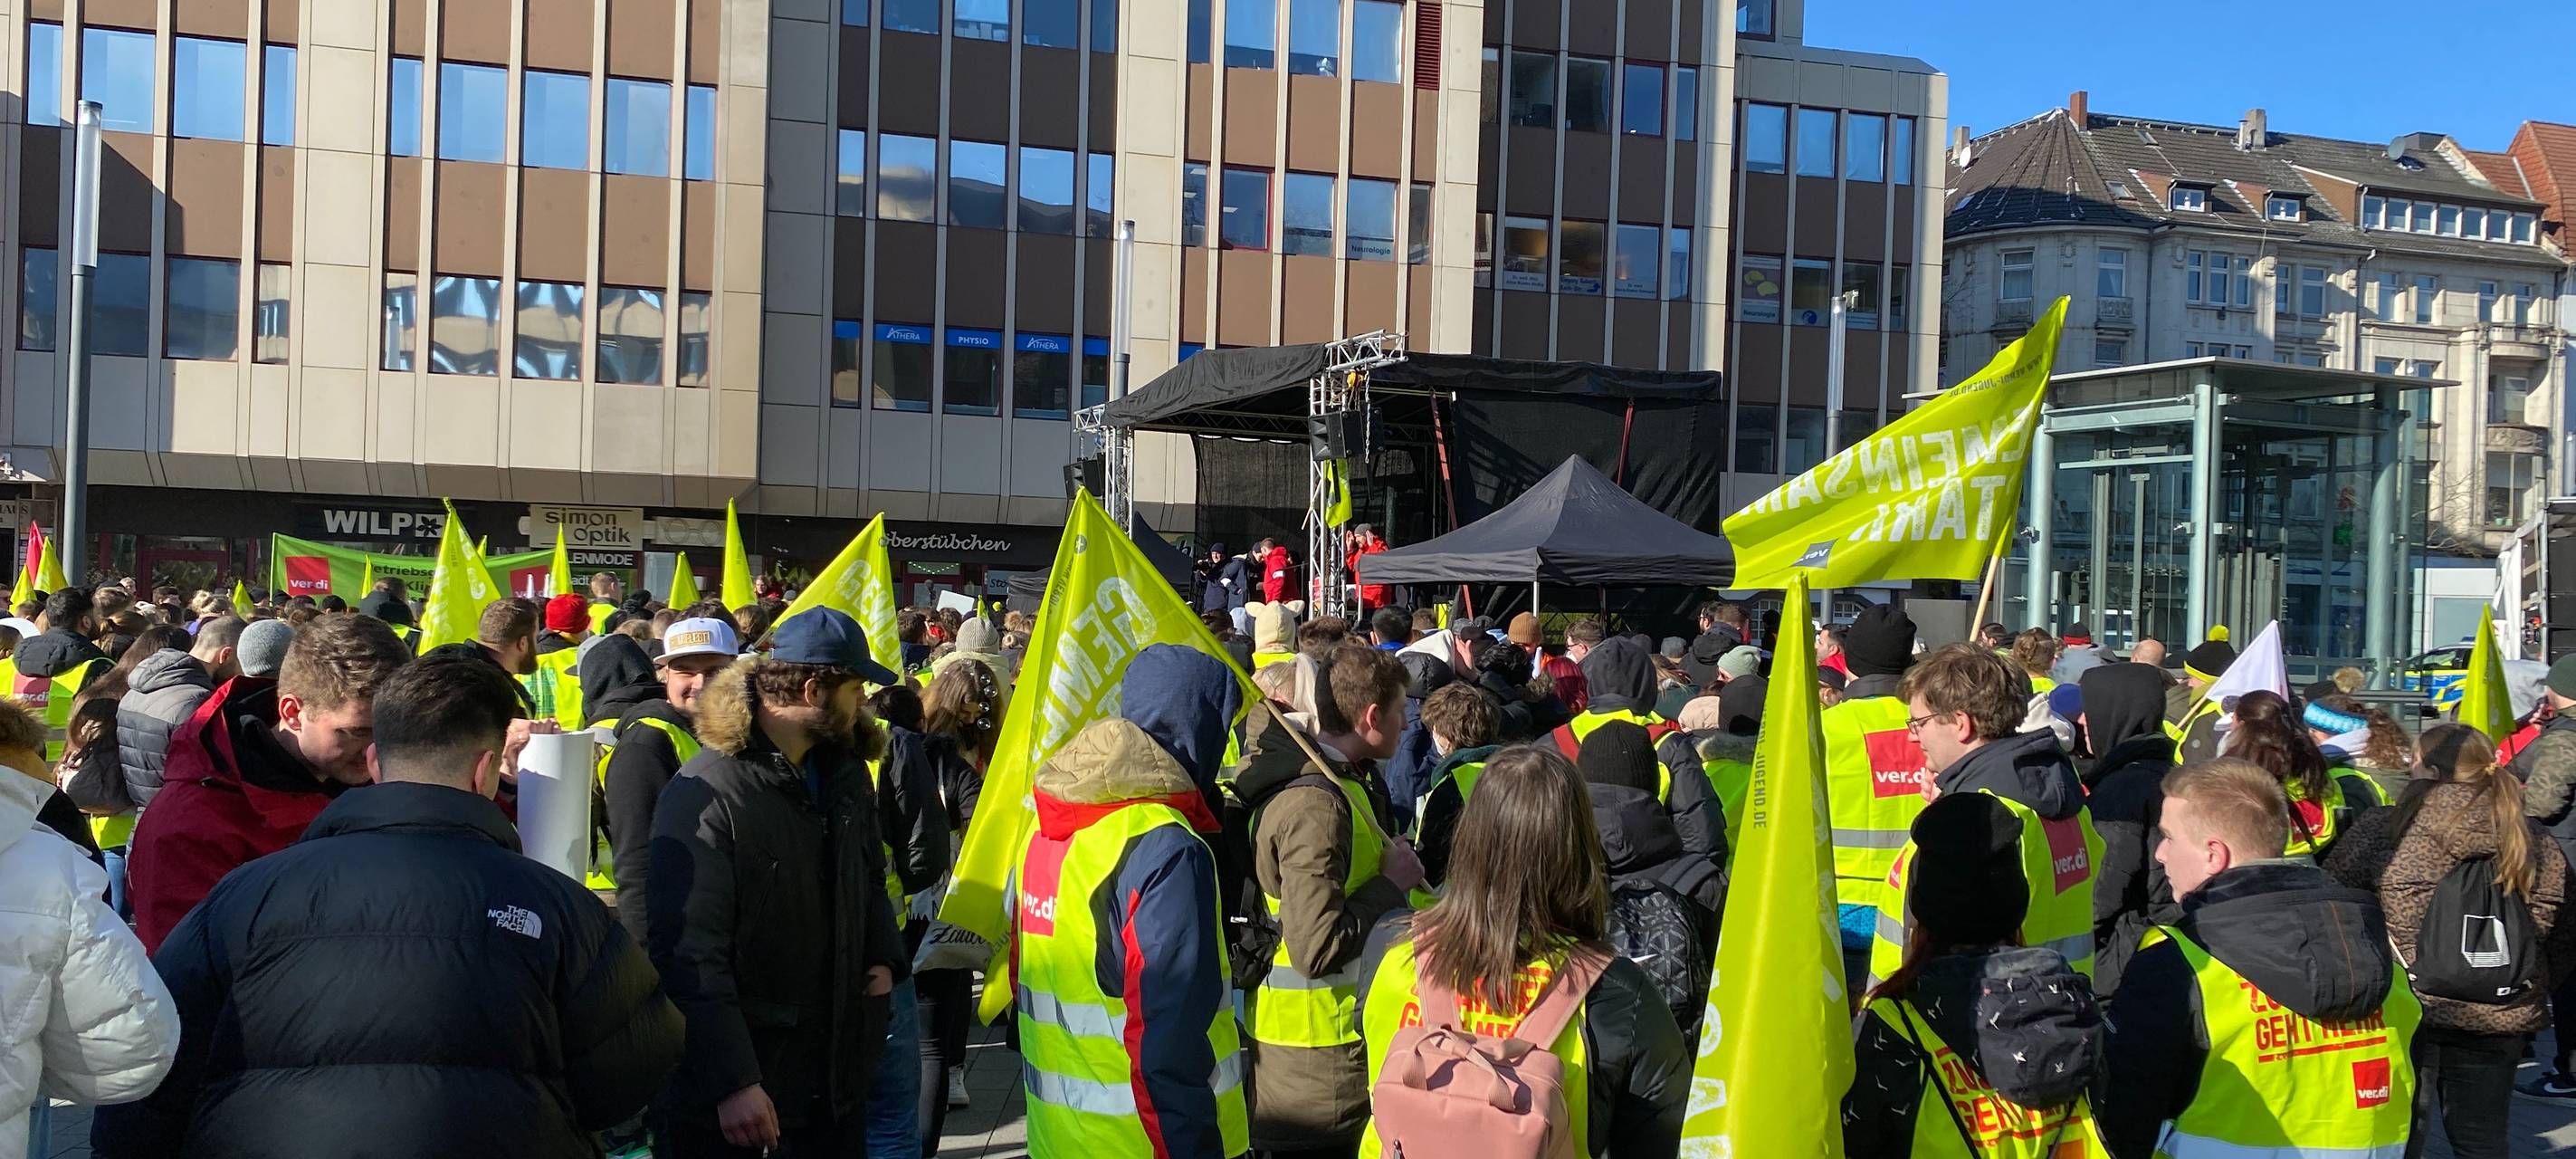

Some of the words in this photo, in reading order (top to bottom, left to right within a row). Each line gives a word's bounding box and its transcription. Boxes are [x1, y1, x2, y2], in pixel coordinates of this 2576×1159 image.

[1351, 245, 1391, 254] Neurologie
[887, 327, 921, 340] ATHERA
[959, 336, 989, 345] PHYSIO
[1027, 337, 1059, 350] ATHERA
[323, 509, 414, 536] WILP
[545, 508, 616, 525] simon
[887, 531, 1011, 551] berstübchen
[1875, 767, 1927, 783] ver.d
[2055, 847, 2087, 875] ver.di
[487, 909, 525, 925] NORTH
[507, 905, 528, 918] THE
[496, 918, 523, 934] FACE
[2255, 1011, 2312, 1050] GEHT
[2357, 1087, 2389, 1099] ver.di
